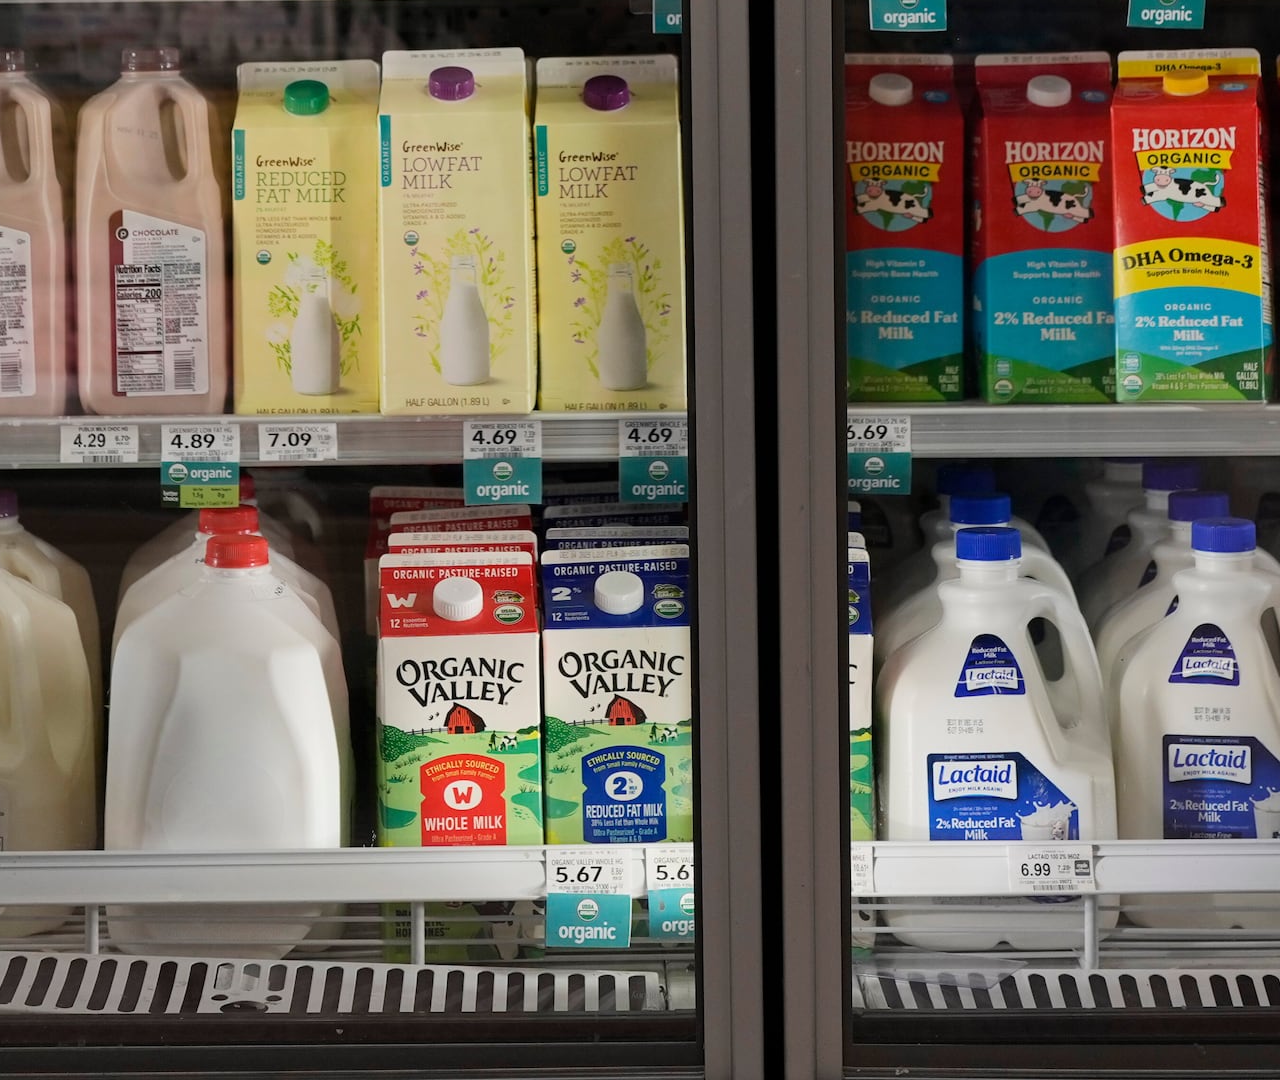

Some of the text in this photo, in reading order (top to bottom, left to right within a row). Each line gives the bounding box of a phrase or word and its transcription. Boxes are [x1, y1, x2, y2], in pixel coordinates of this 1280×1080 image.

[1132, 127, 1236, 152] HORIZON
[1122, 248, 1254, 271] DHA Omega-3
[1146, 268, 1230, 279] Supports Brain Health
[1135, 315, 1244, 328] 2% Reduced Fat
[1173, 329, 1205, 341] Milk
[73, 434, 106, 448] 4.29
[170, 434, 215, 449] 4.89
[268, 433, 312, 447] 7.09
[472, 429, 517, 445] 4.69
[628, 427, 673, 443] 4.69
[476, 482, 529, 499] organic
[396, 657, 525, 687] ORGANIC
[408, 681, 515, 708] VALLEY
[1173, 748, 1247, 770] Lactaid
[937, 764, 1012, 786] Lactaid
[586, 804, 663, 818] REDUCED FAT MILK
[1198, 811, 1221, 823] Milk
[936, 818, 1016, 830] 2% Reduced Fat
[556, 867, 602, 883] 5.67
[1020, 863, 1051, 877] 6.99
[558, 923, 616, 941] organic
